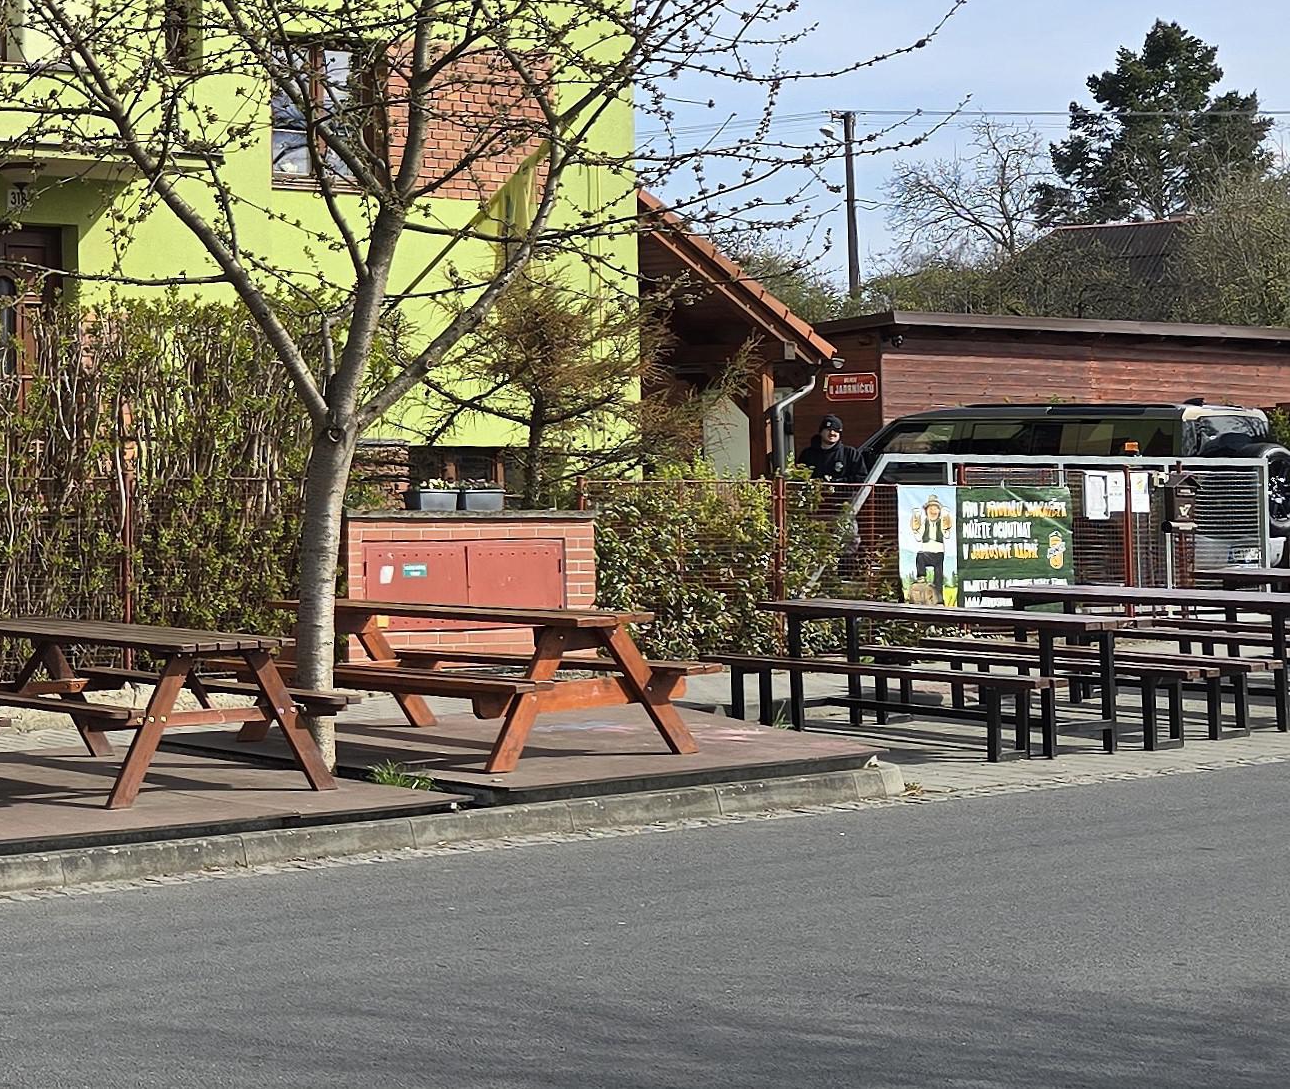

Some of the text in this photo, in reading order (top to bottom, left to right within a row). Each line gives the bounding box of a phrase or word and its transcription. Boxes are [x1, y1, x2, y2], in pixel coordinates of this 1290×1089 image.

[10, 191, 27, 206] 318
[980, 501, 986, 518] Z
[963, 519, 1031, 539] MŮŽETE OCHUTNAT
[963, 543, 969, 560] V
